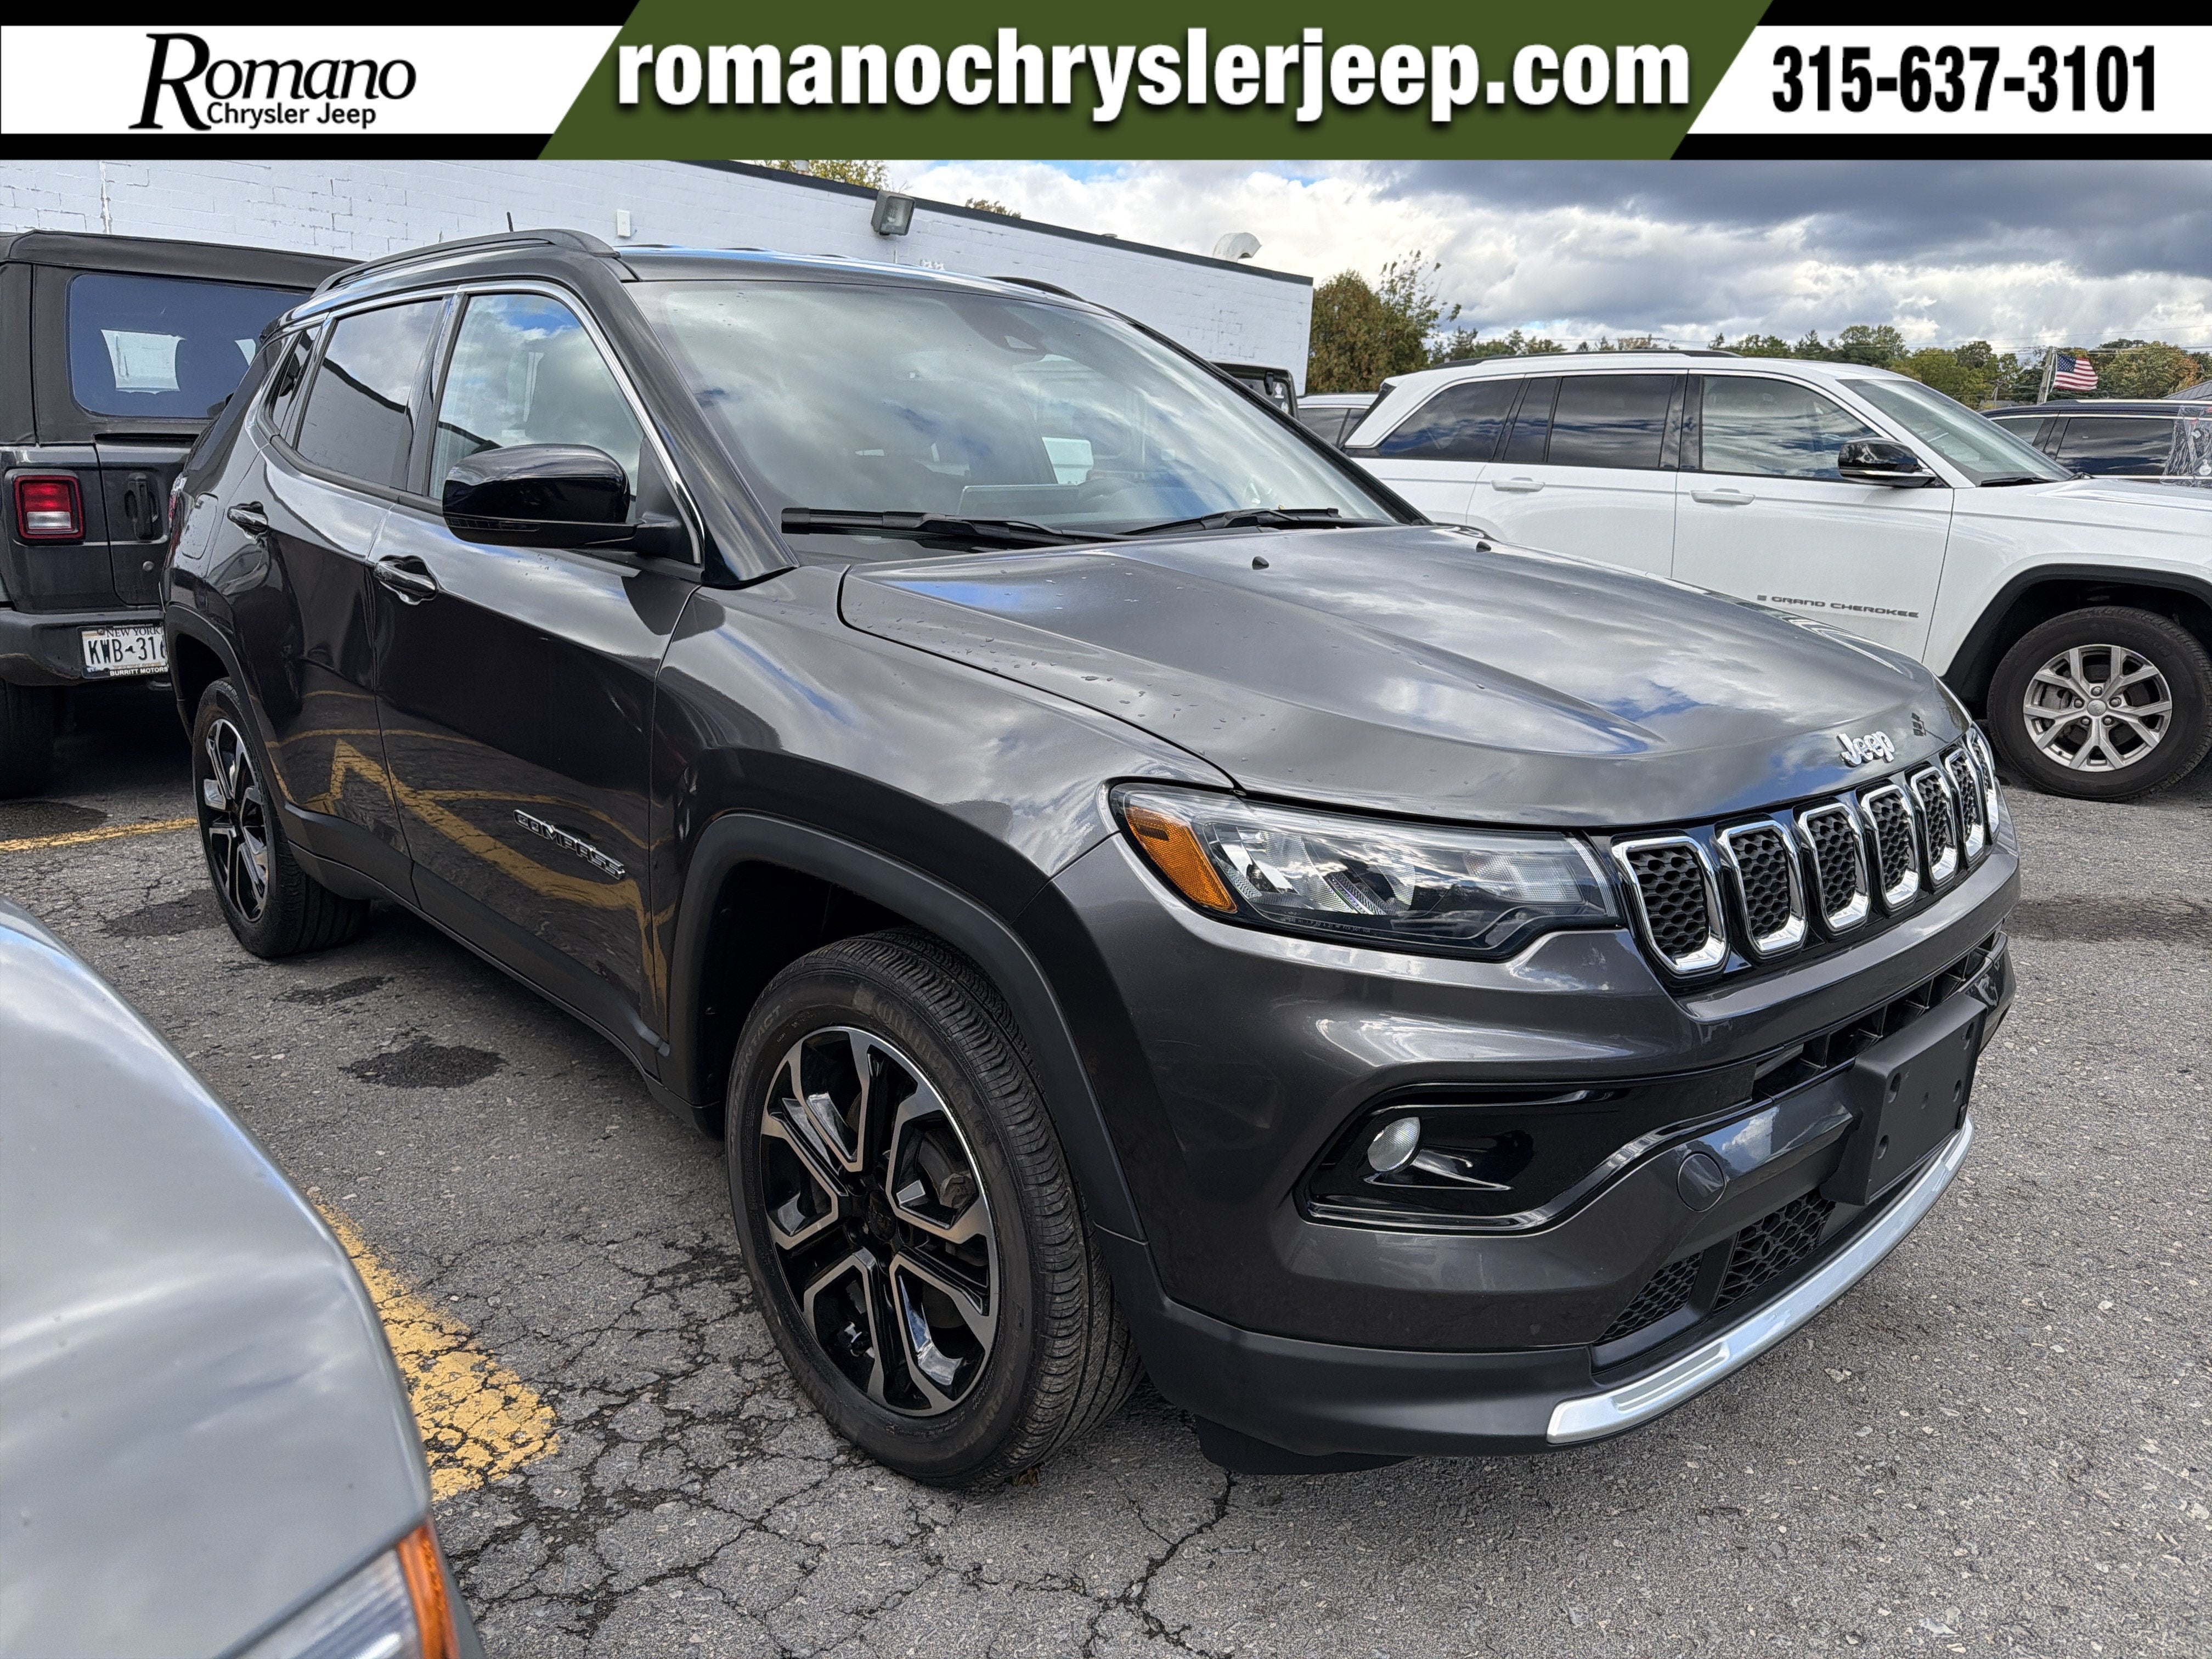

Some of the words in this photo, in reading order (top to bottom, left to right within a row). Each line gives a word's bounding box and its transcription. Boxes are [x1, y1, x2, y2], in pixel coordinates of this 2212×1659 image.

[1771, 596, 1826, 607] GRAND
[1830, 602, 1919, 618] CHEROKEE
[106, 629, 130, 637] NEW
[133, 627, 162, 636] YORK
[1836, 731, 1895, 768] Jeep
